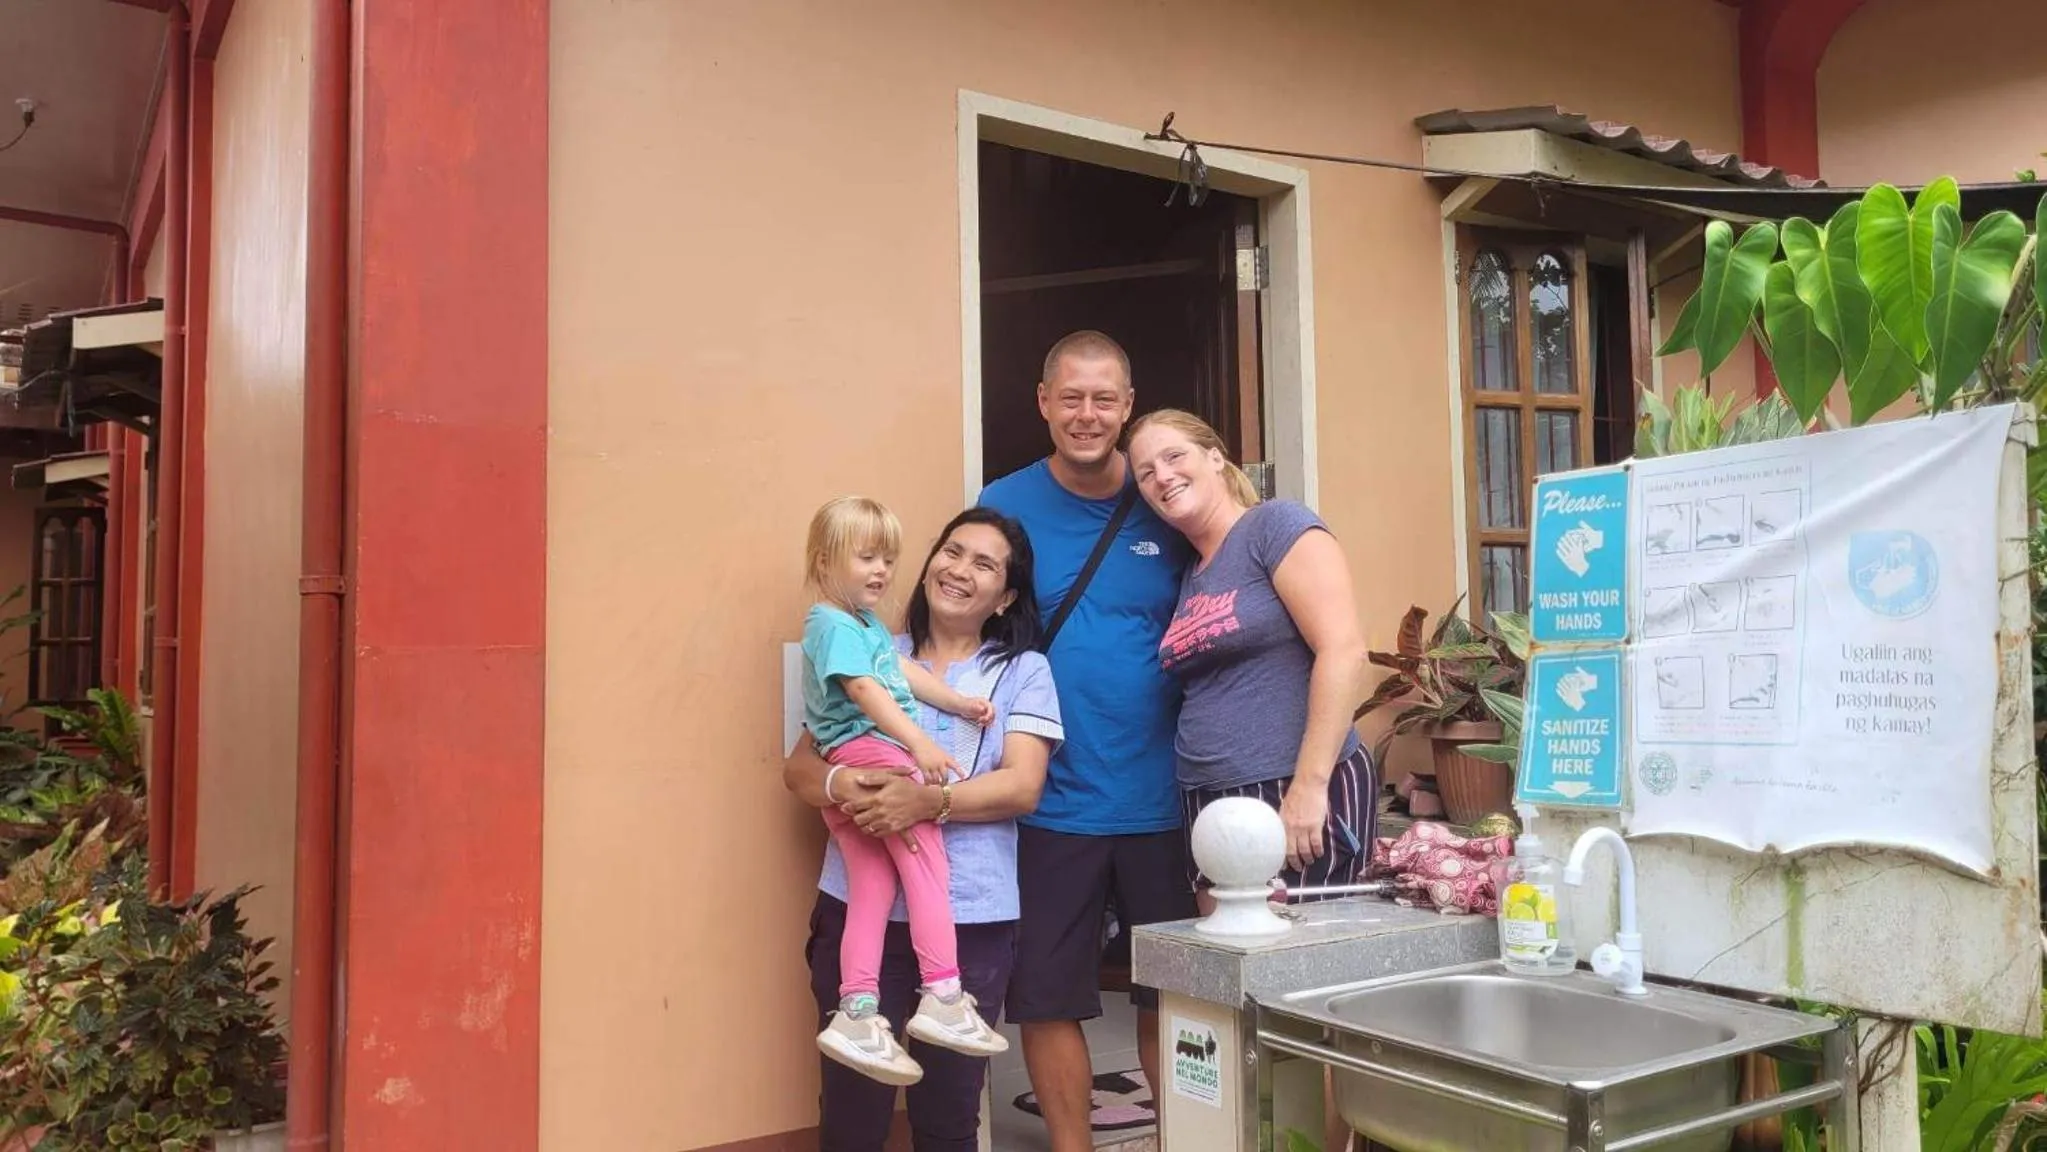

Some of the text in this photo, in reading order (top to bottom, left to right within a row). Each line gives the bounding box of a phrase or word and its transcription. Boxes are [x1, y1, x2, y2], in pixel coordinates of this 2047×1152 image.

[1543, 489, 1622, 516] Please...
[1539, 588, 1619, 610] WASH YOUR
[1555, 612, 1602, 631] HANDS
[1842, 643, 1933, 664] Ugaliin ang
[1839, 668, 1933, 686] madalas na
[1836, 691, 1936, 711] paghuhugas
[1541, 717, 1609, 736] SANITIZE
[1846, 713, 1932, 735] ng kamay!
[1547, 737, 1601, 756] HANDS
[1552, 757, 1594, 776] HERE
[1176, 1059, 1218, 1079] AVVENTURE
[1176, 1067, 1218, 1088] NEL MONDO
